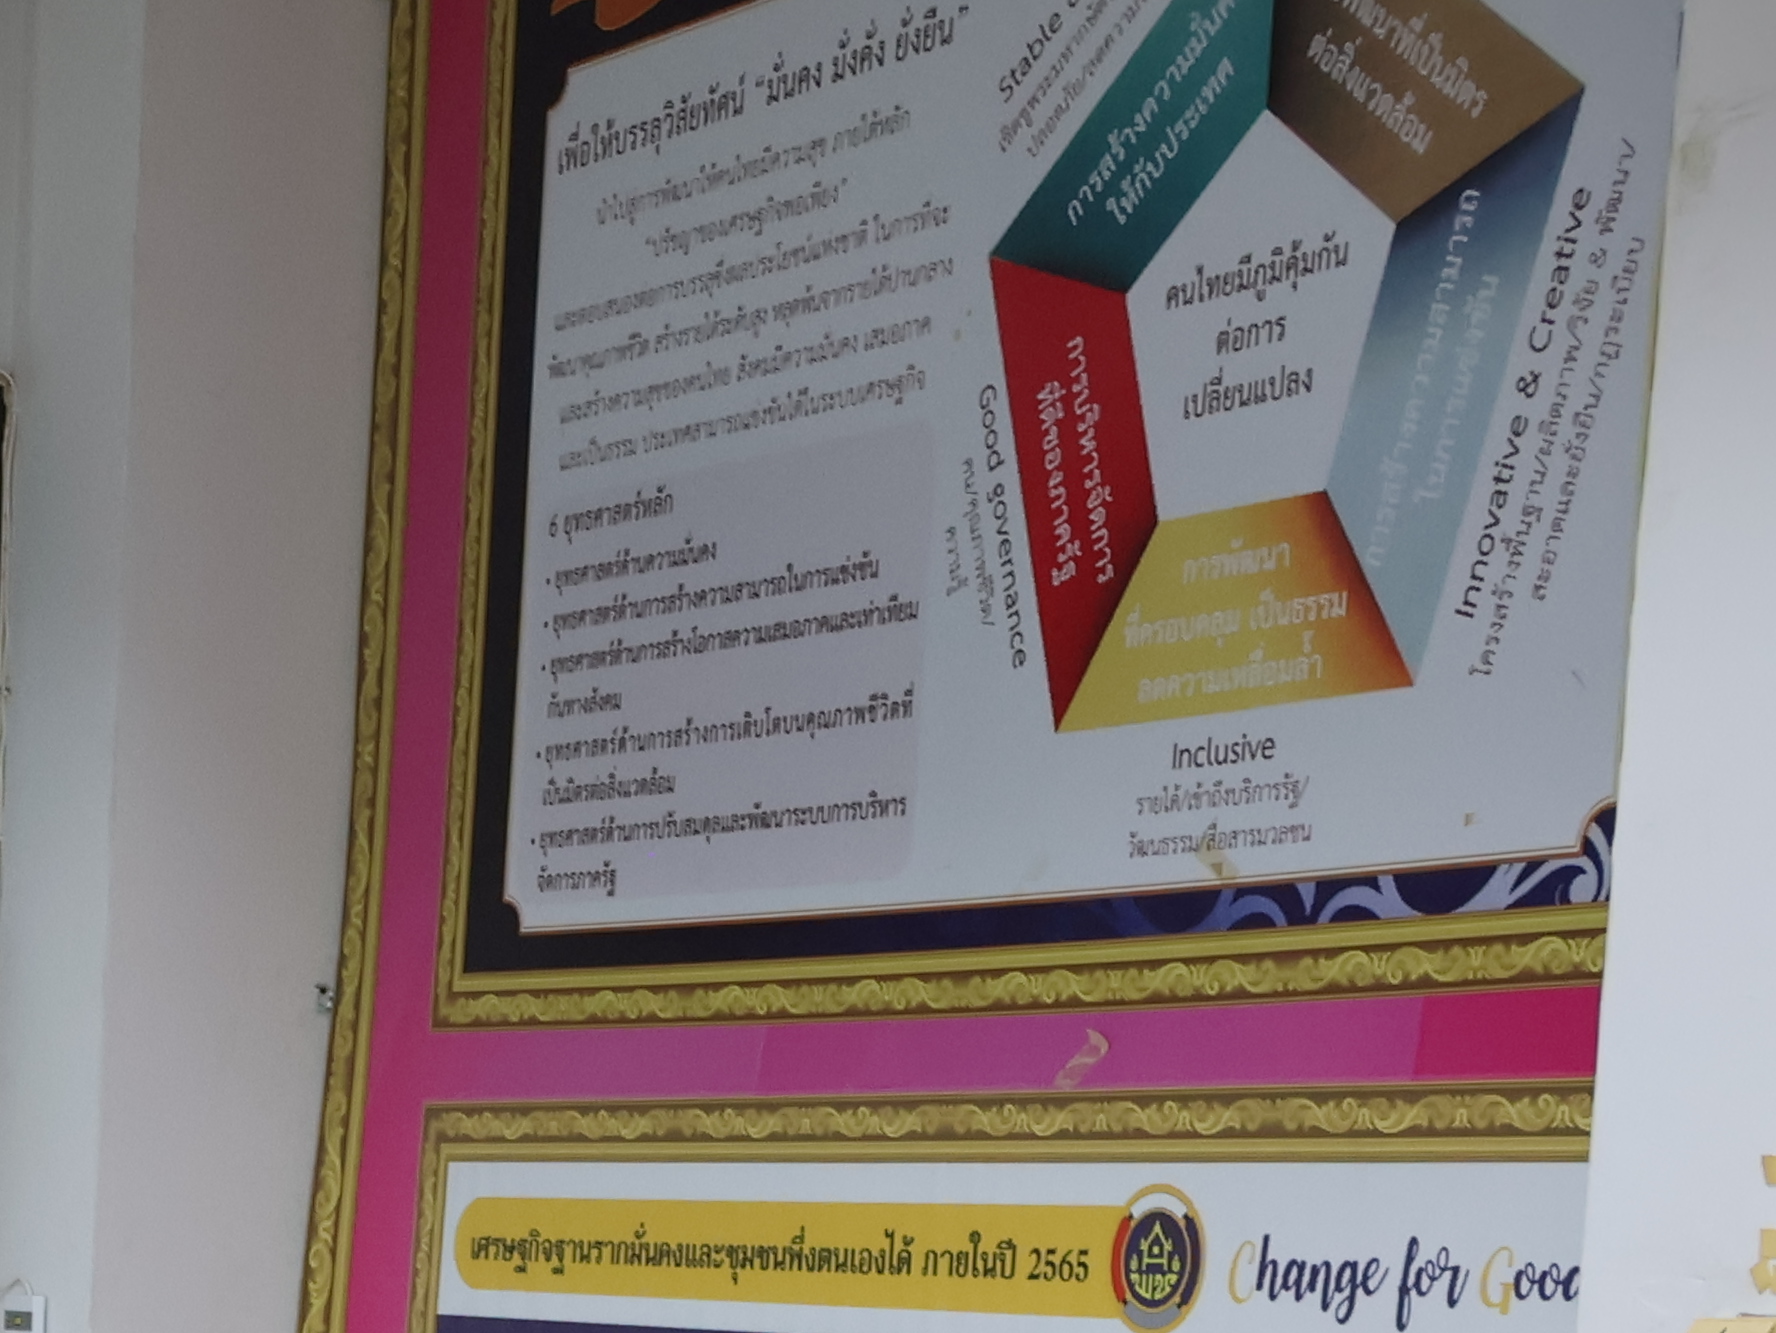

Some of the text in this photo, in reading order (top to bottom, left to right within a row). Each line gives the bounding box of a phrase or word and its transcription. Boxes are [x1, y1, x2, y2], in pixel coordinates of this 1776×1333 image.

[1165, 231, 1350, 312] คนไทยมีภูมิคุ้มกัน
[1216, 314, 1287, 357] ต่อการ
[1182, 366, 1314, 421] เปลี่ยนแปลง
[1454, 186, 1592, 620] Innovative & Creative
[978, 384, 1027, 670] Good governance
[1171, 733, 1277, 772] Inclusive
[470, 1222, 1090, 1285] เศรษฐกิจฐานรากมั่นคงและชุมชนพึ่งตนเองได้ ภายในปี 2565
[1228, 1233, 1389, 1326] Change
[1397, 1235, 1471, 1332] for
